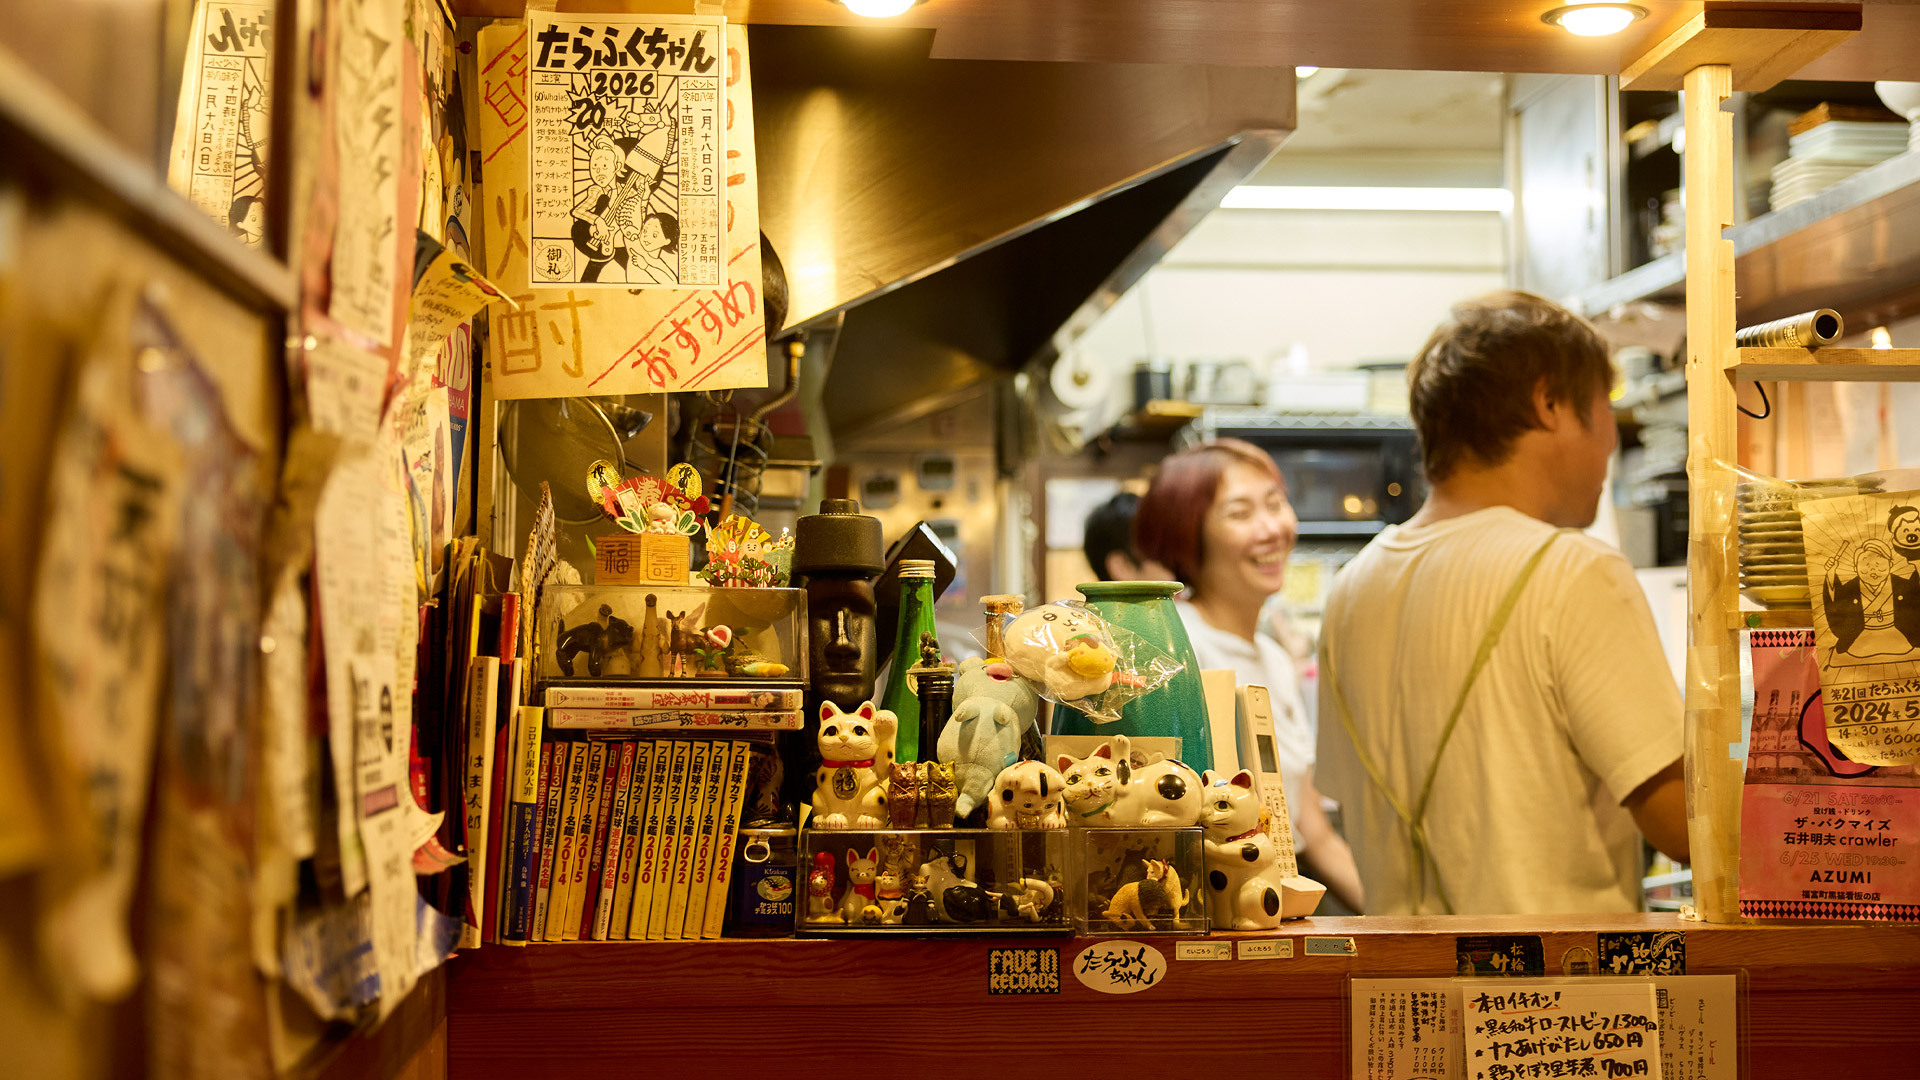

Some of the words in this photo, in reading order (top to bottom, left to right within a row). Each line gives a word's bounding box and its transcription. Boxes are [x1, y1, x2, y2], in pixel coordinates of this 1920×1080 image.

[535, 23, 717, 73] たらふくちゃん
[541, 73, 561, 84] 出演
[593, 71, 656, 97] 2026
[682, 79, 714, 89] イベント
[681, 91, 714, 102] 令和八年
[536, 118, 563, 127] タケヒサ
[535, 159, 568, 167] セーターズ
[546, 248, 562, 276] 御礼
[631, 277, 757, 388] おすすめ
[605, 542, 630, 574] 福
[523, 726, 538, 797] コロナ自粛の大罪
[540, 751, 550, 779] 2012
[551, 744, 564, 787] 2013
[619, 744, 633, 787] 2018
[467, 754, 485, 830] はま太郎
[835, 773, 857, 798] 福
[1828, 792, 1859, 806] SAT
[1794, 816, 1892, 831] ザ・バクマイズ
[1783, 832, 1836, 846] 石井明夫
[1839, 832, 1898, 847] crawler
[1825, 852, 1864, 867] WED
[1809, 870, 1872, 884] AZUMI
[778, 902, 793, 915] 100
[990, 949, 1038, 974] FADE
[1039, 949, 1059, 974] IN
[1080, 946, 1148, 974] たらふく
[1510, 942, 1526, 972] 松輪
[989, 972, 1059, 990] RECORDS
[1110, 967, 1158, 987] ちゃん
[1484, 1012, 1610, 1039] 黒毛和牛ローストビーフ
[1488, 1036, 1591, 1061] ナスあげびたし
[1593, 1032, 1644, 1050] 650円
[1709, 1039, 1717, 1065] ビール
[1601, 1058, 1649, 1079] 700円
